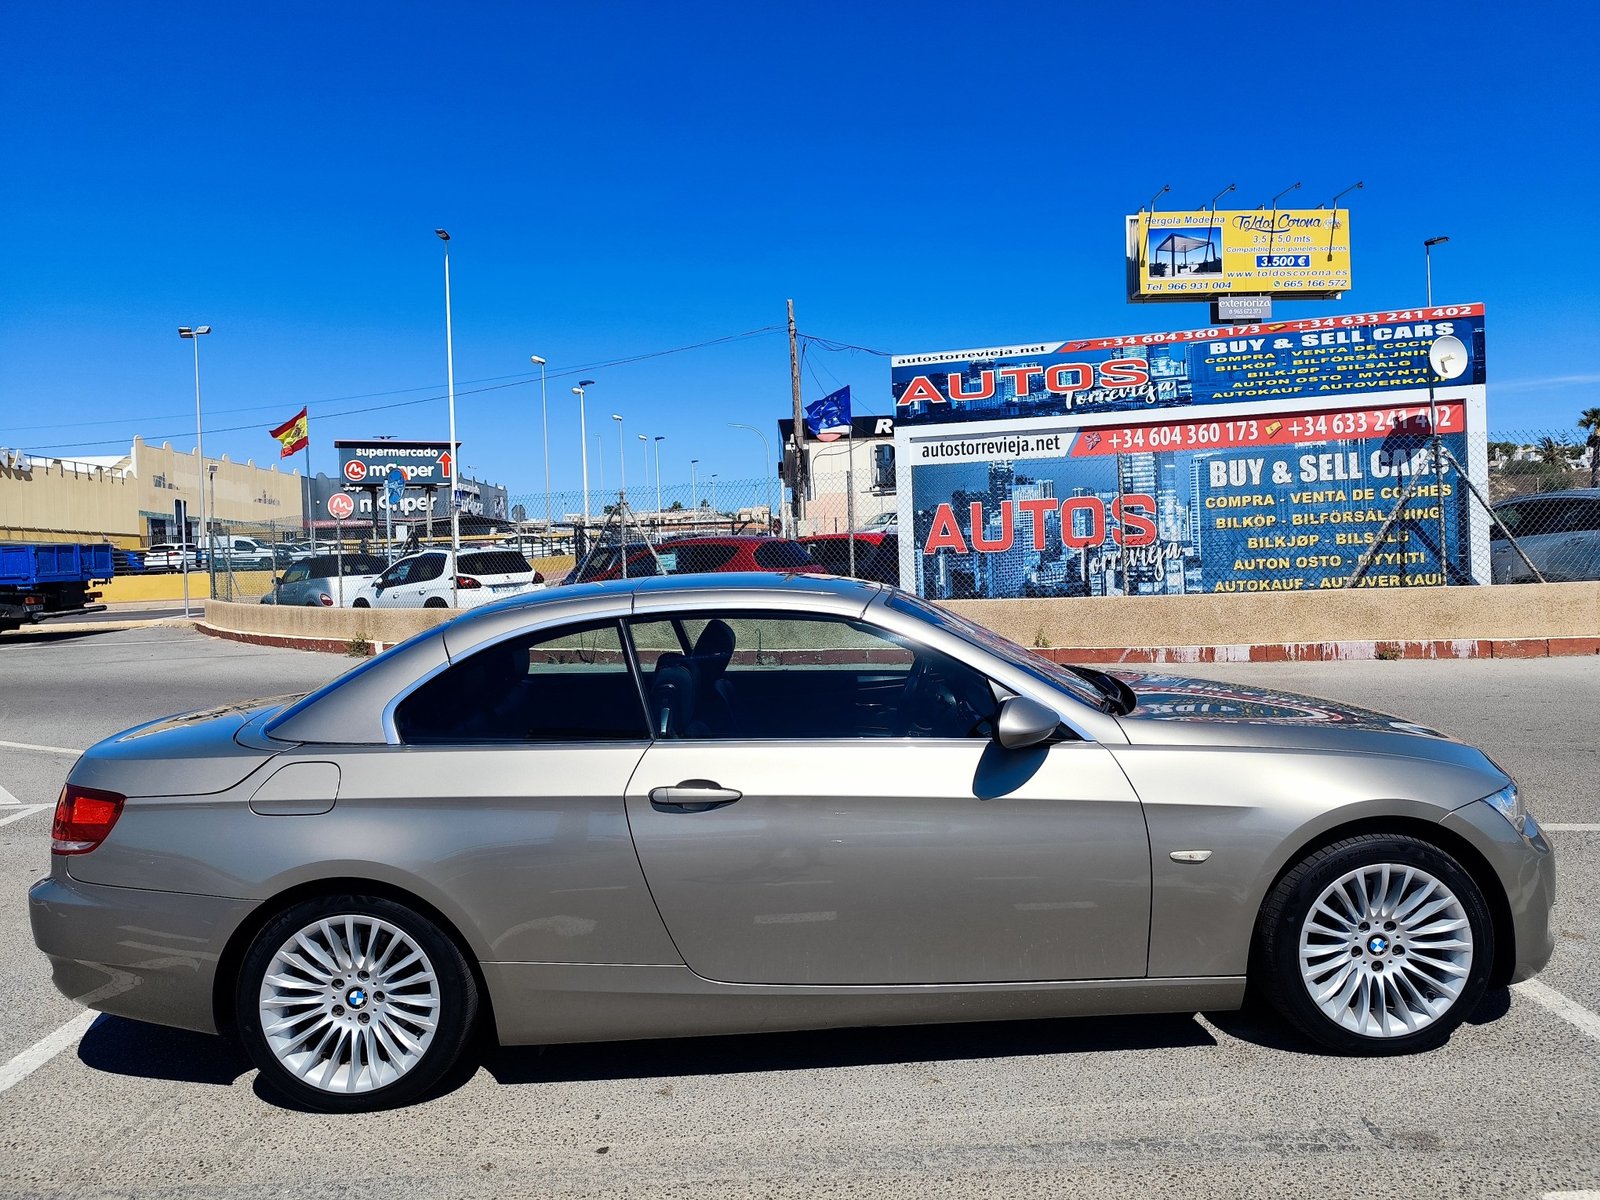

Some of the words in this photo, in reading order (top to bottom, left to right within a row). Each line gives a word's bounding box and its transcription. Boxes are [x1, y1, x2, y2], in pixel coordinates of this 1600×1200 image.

[1145, 216, 1181, 226] Pergola
[1185, 215, 1225, 224] Modena
[1277, 213, 1321, 229] Corona
[1260, 256, 1295, 267] 3.500
[1297, 256, 1307, 267] €
[1167, 282, 1187, 290] 966
[1189, 282, 1209, 290] 931
[1212, 281, 1231, 289] 004
[1283, 280, 1303, 288] 665
[1307, 280, 1325, 288] 166
[1219, 298, 1271, 307] exterioriza
[1292, 318, 1336, 329] +34
[1341, 314, 1379, 325] 633
[1386, 309, 1424, 321] 241
[1431, 306, 1472, 317] 402
[1098, 336, 1137, 346] +34
[1142, 333, 1178, 343] 604
[1183, 329, 1219, 339] 360
[1225, 325, 1261, 335] 173
[1210, 339, 1265, 355] BUY
[1273, 337, 1293, 349] &
[1301, 329, 1365, 346] SELL
[1373, 322, 1455, 340] CARS
[897, 345, 1046, 365] autostorrevieja.net
[1205, 353, 1275, 364] COMPRA
[1291, 347, 1348, 356] VENTA
[1383, 340, 1433, 349] COCH
[1215, 361, 1276, 372] BILKÖP
[1292, 349, 1428, 366] BILFÖRSÄLJNIN
[1336, 360, 1411, 371] BILSALG
[895, 357, 1150, 407] AUTOS
[1232, 379, 1290, 388] AUTON
[1295, 375, 1342, 383] OSTO
[1358, 368, 1427, 378] MYYNTI
[1063, 381, 1176, 410] Torrevieja
[1212, 387, 1303, 398] AUTOKAUF
[1288, 416, 1328, 437] +34
[1332, 412, 1368, 434] 633
[1373, 409, 1408, 431] 241
[1415, 406, 1451, 428] 402
[1108, 428, 1144, 448] +34
[1149, 426, 1182, 446] 604
[1186, 423, 1220, 445] 360
[1228, 420, 1259, 442] 173
[356, 448, 438, 459] supermercado
[921, 434, 1061, 458] autostorrevieja.net
[369, 463, 435, 481] maper
[1209, 458, 1265, 487] BUY
[1272, 460, 1292, 484] &
[1299, 452, 1362, 482] SELL
[1370, 448, 1450, 478] CARS
[1205, 494, 1275, 509] COMPRA
[1290, 490, 1347, 505] VENTA
[1352, 488, 1375, 501] DE
[923, 494, 1158, 555] AUTOS
[1215, 515, 1277, 529] BILKÖP
[1247, 534, 1320, 549] BILKJØP
[1335, 530, 1409, 545] BILSLG
[1233, 557, 1290, 571] AUTON
[1296, 555, 1342, 569] OSTO
[1214, 578, 1304, 592] AUTOKAUF
